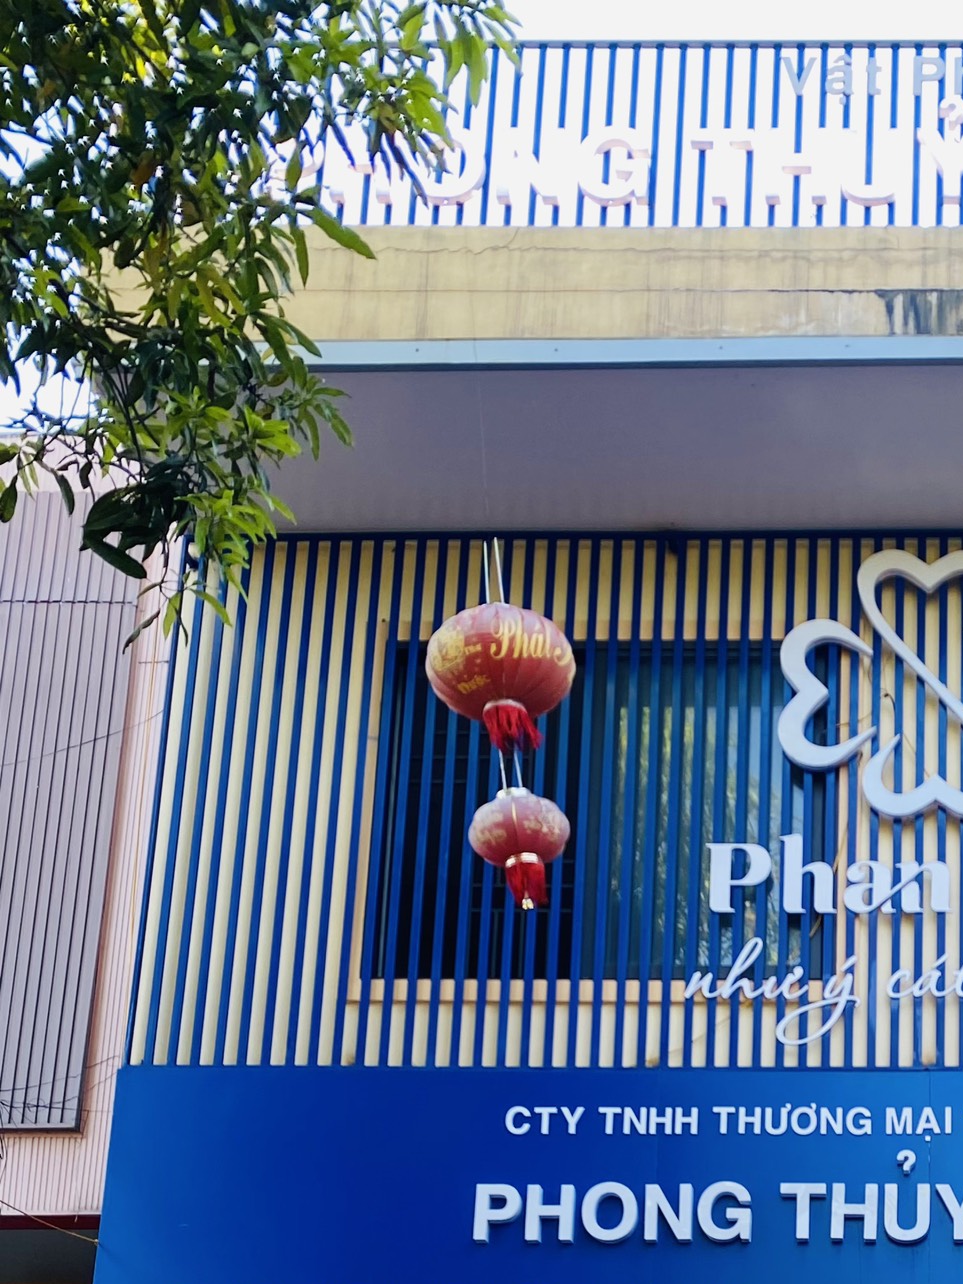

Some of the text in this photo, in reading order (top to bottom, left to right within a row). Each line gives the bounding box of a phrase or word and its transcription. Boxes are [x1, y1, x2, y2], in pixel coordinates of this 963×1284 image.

[781, 53, 882, 106] Vật
[705, 833, 951, 915] Phan
[684, 937, 809, 1001] như
[775, 955, 861, 1047] ý
[504, 1105, 585, 1136] CTY
[599, 1106, 699, 1136] TNHH
[713, 1102, 873, 1136] THƯƠNG
[885, 1106, 952, 1142] MẠI
[471, 1181, 753, 1245] PHONG
